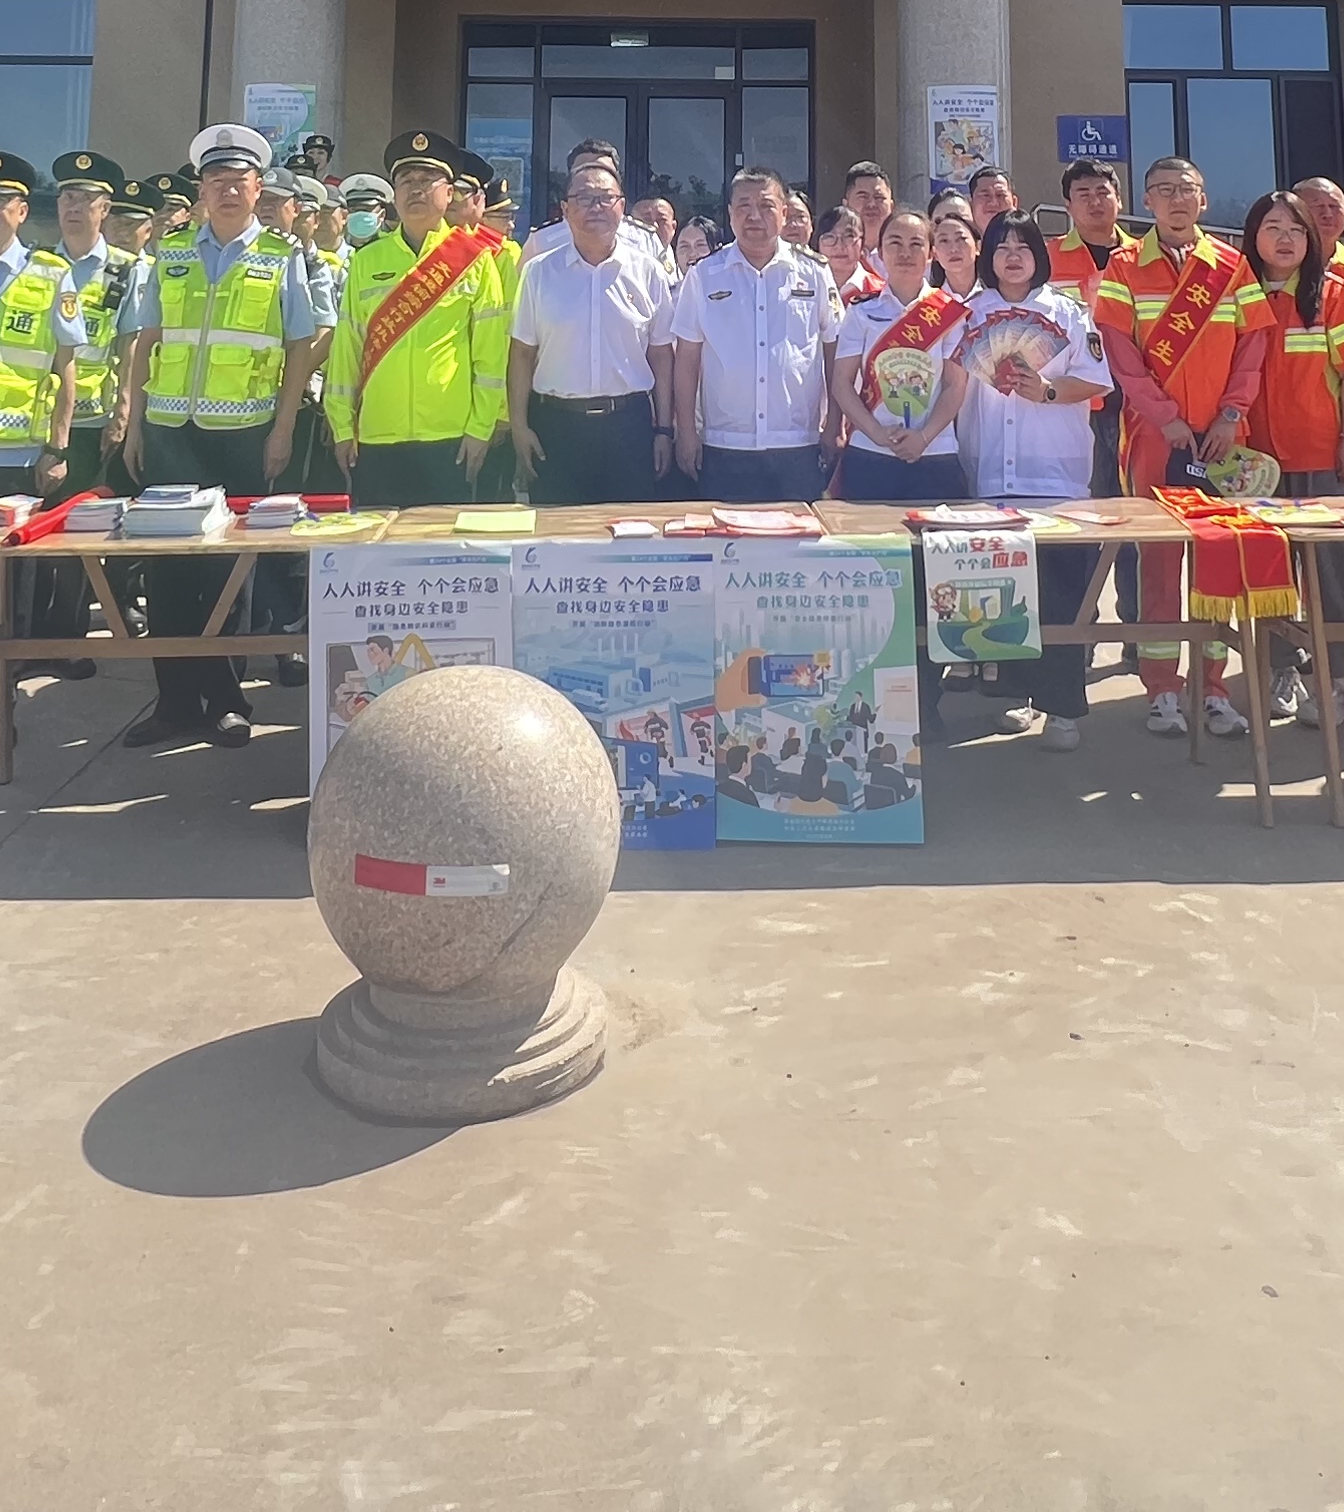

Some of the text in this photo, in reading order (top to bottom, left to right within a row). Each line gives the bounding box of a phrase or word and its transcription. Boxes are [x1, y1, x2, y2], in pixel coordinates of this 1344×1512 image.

[7, 309, 37, 335] 通
[322, 576, 499, 600] 人人讲安全 个个会应急
[524, 574, 702, 594] 人人讲安全 个个会应急
[724, 570, 901, 589] 人人讲安全 个个会应急
[354, 600, 469, 618] 查找身边安全隐患
[556, 599, 669, 614] 查找身边安全隐患
[757, 594, 870, 609] 查找身边安全隐患
